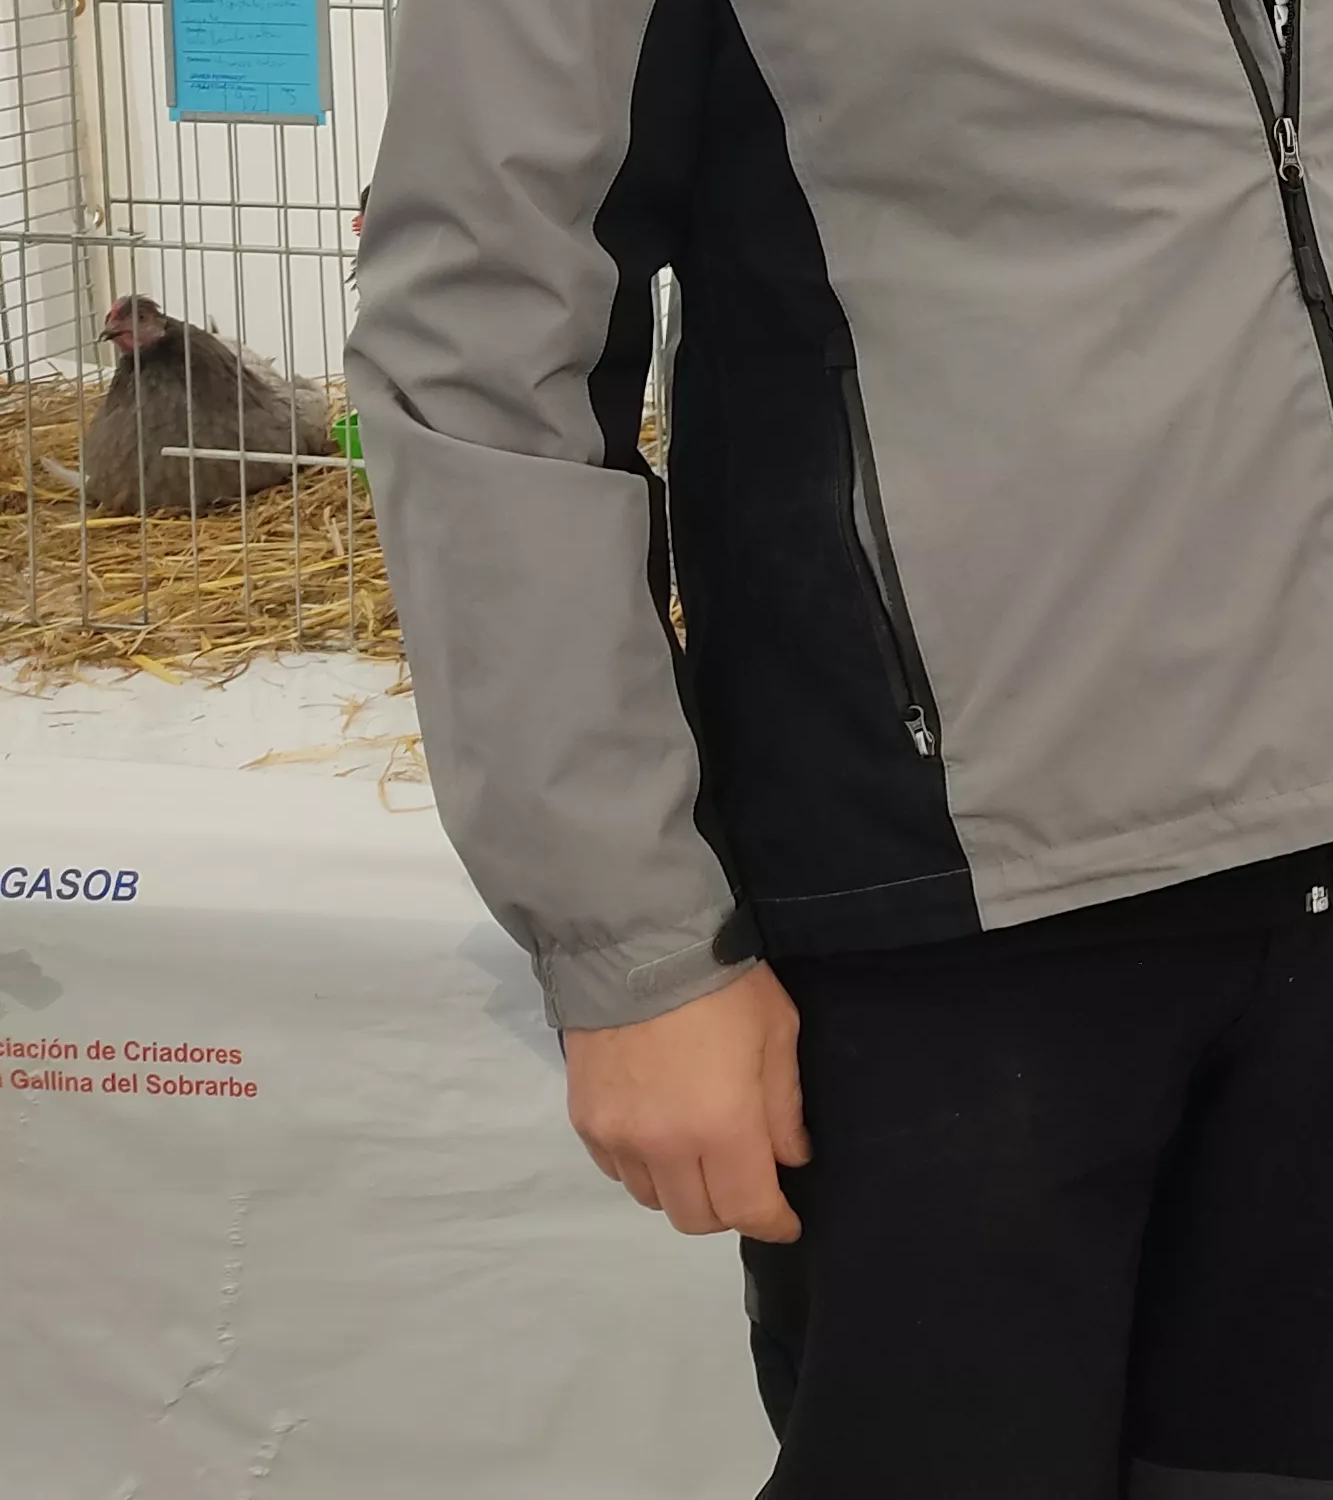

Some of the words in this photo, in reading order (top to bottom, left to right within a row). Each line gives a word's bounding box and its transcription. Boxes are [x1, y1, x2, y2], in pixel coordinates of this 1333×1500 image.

[87, 1040, 117, 1061] de
[124, 1040, 243, 1065] Criadores
[10, 1069, 93, 1093] Gallina
[102, 1072, 138, 1094] del
[146, 1073, 259, 1098] Sobrarbe
